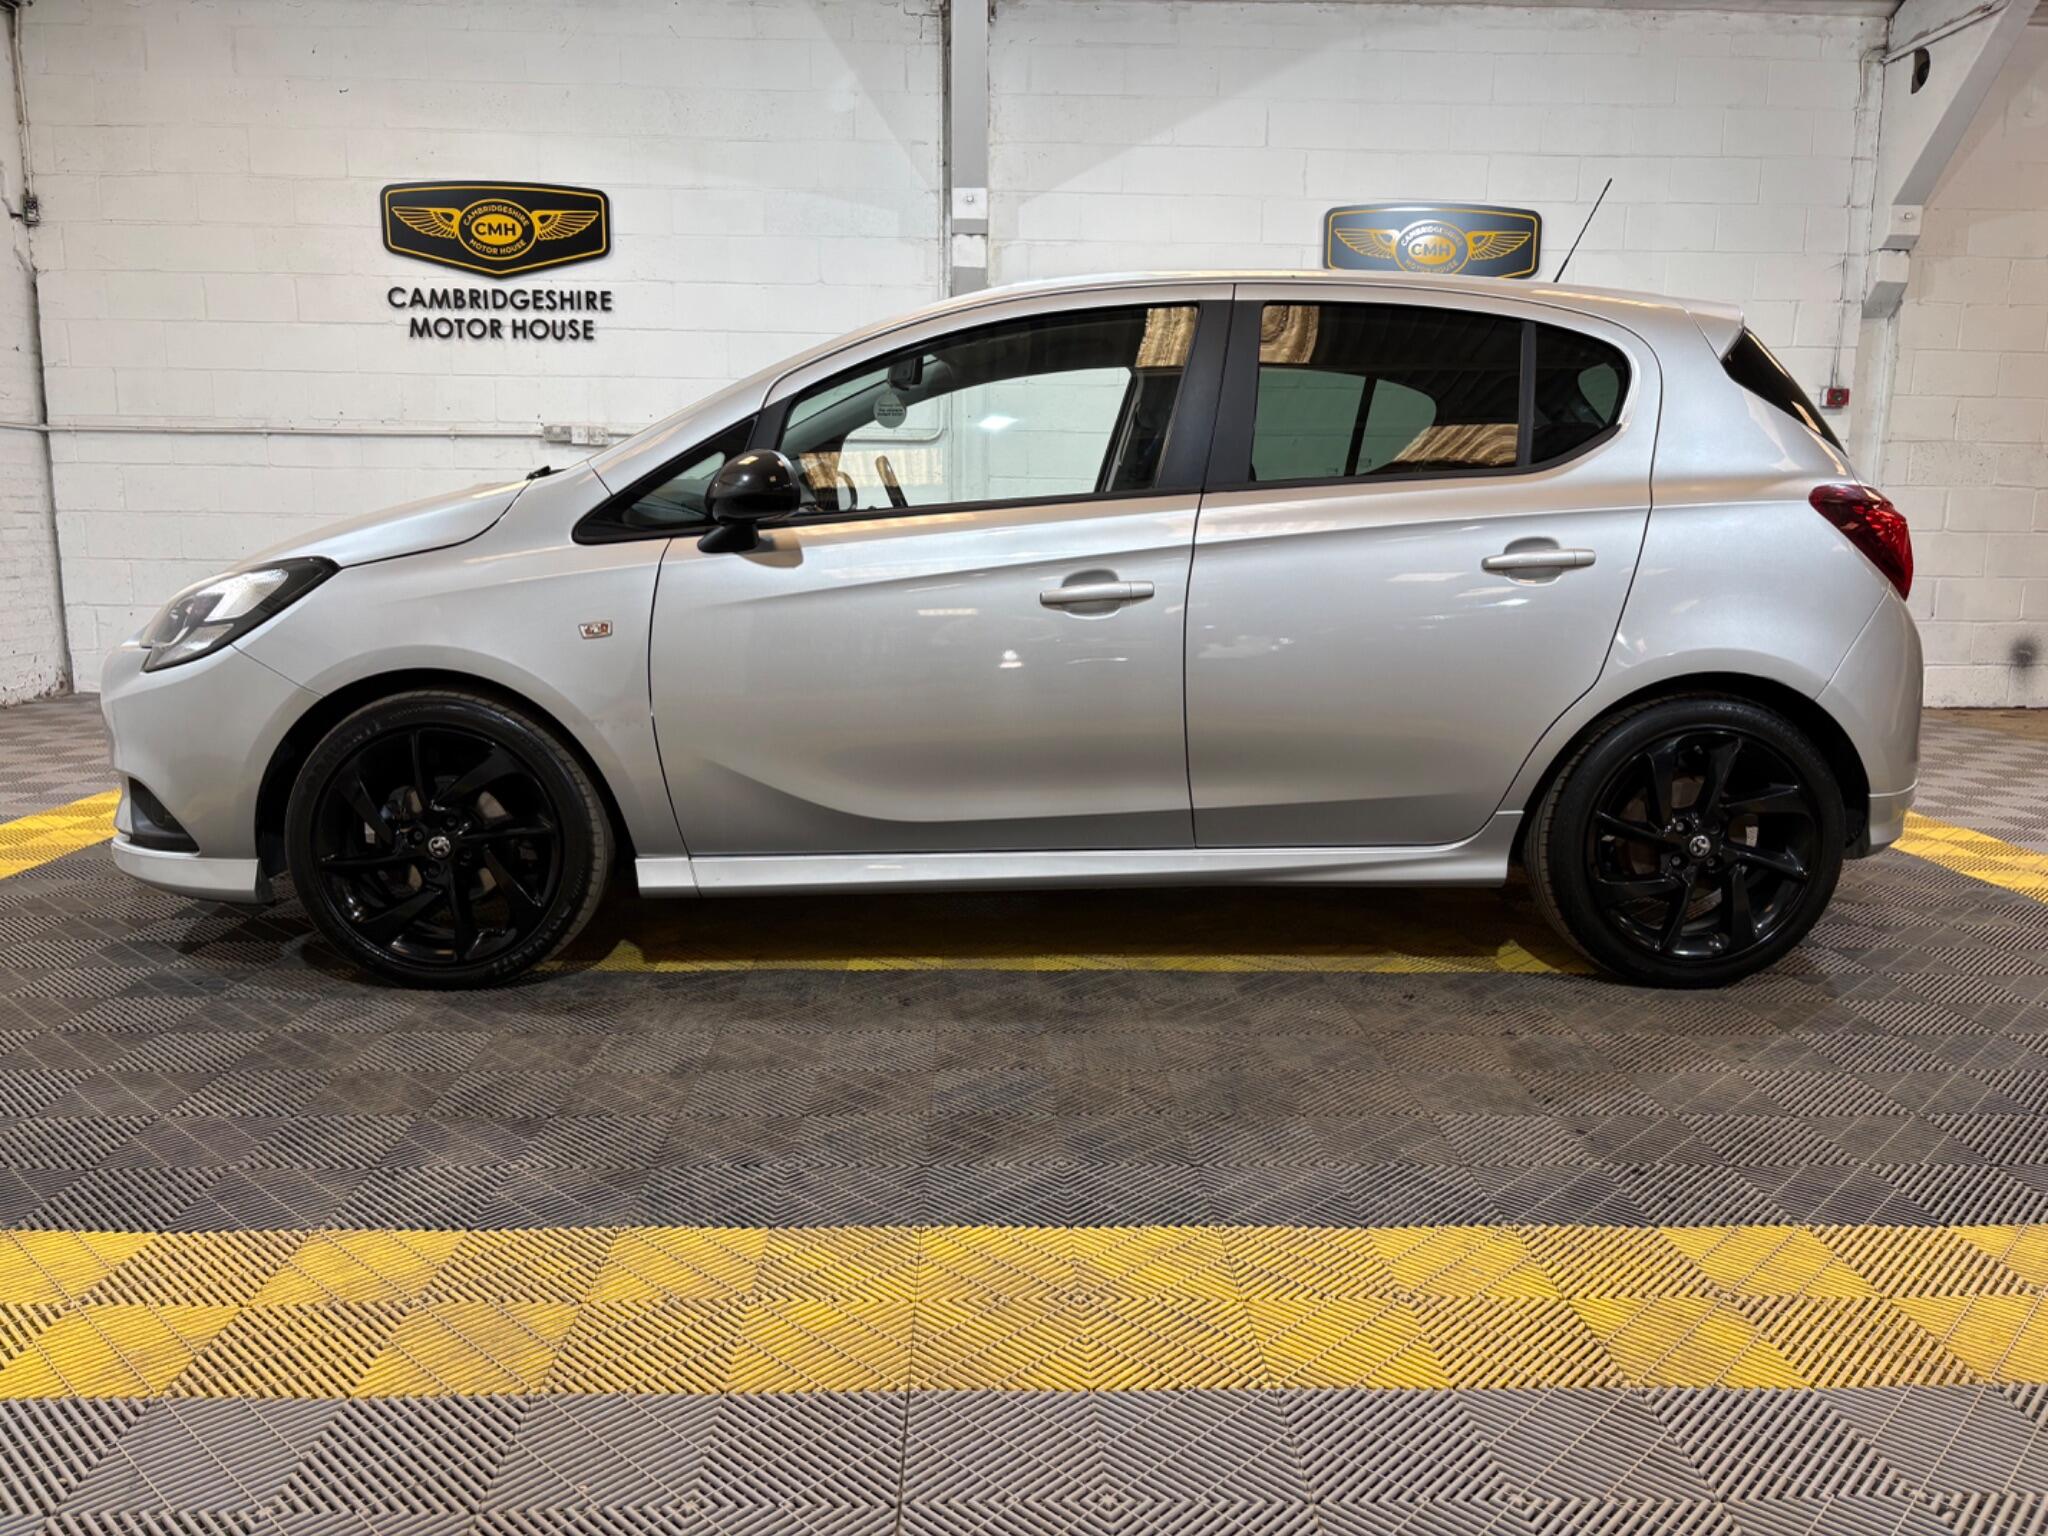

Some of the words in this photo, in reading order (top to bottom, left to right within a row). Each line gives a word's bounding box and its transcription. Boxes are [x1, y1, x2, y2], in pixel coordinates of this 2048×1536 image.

[463, 205, 529, 226] CAMBRIDGESHIRE
[474, 222, 517, 236] CMH
[469, 238, 498, 254] MOTOR
[500, 239, 527, 254] HOUSE
[1411, 242, 1451, 257] CMH
[388, 286, 613, 311] CAMBRIDGESHIRE
[409, 317, 503, 339] MOTOR
[511, 318, 594, 340] HOUSE
